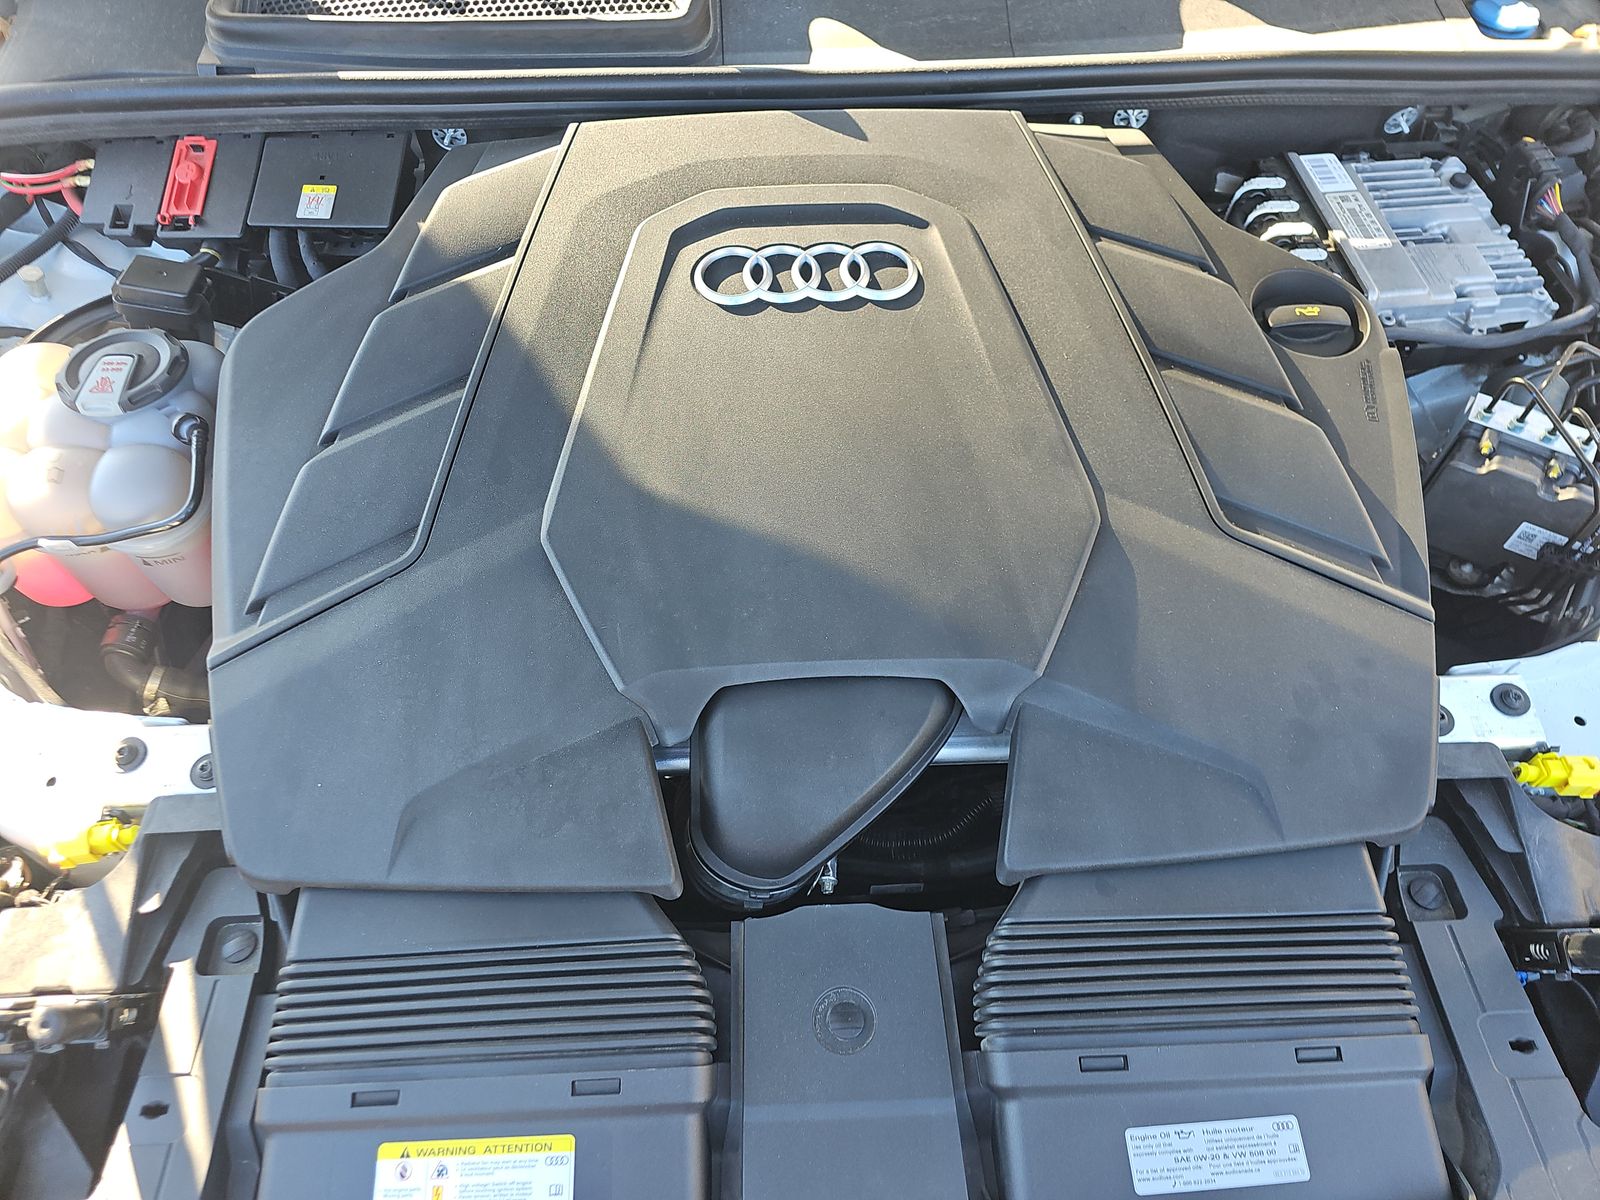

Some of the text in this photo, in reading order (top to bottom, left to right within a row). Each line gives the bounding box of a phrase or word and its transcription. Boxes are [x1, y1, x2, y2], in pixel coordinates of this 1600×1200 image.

[1201, 1126, 1254, 1136] Huile moteur
[1129, 1131, 1171, 1142] Engine Oil
[416, 1142, 553, 1158] WARNING ATTENTION
[1193, 1154, 1220, 1162] 0W-20
